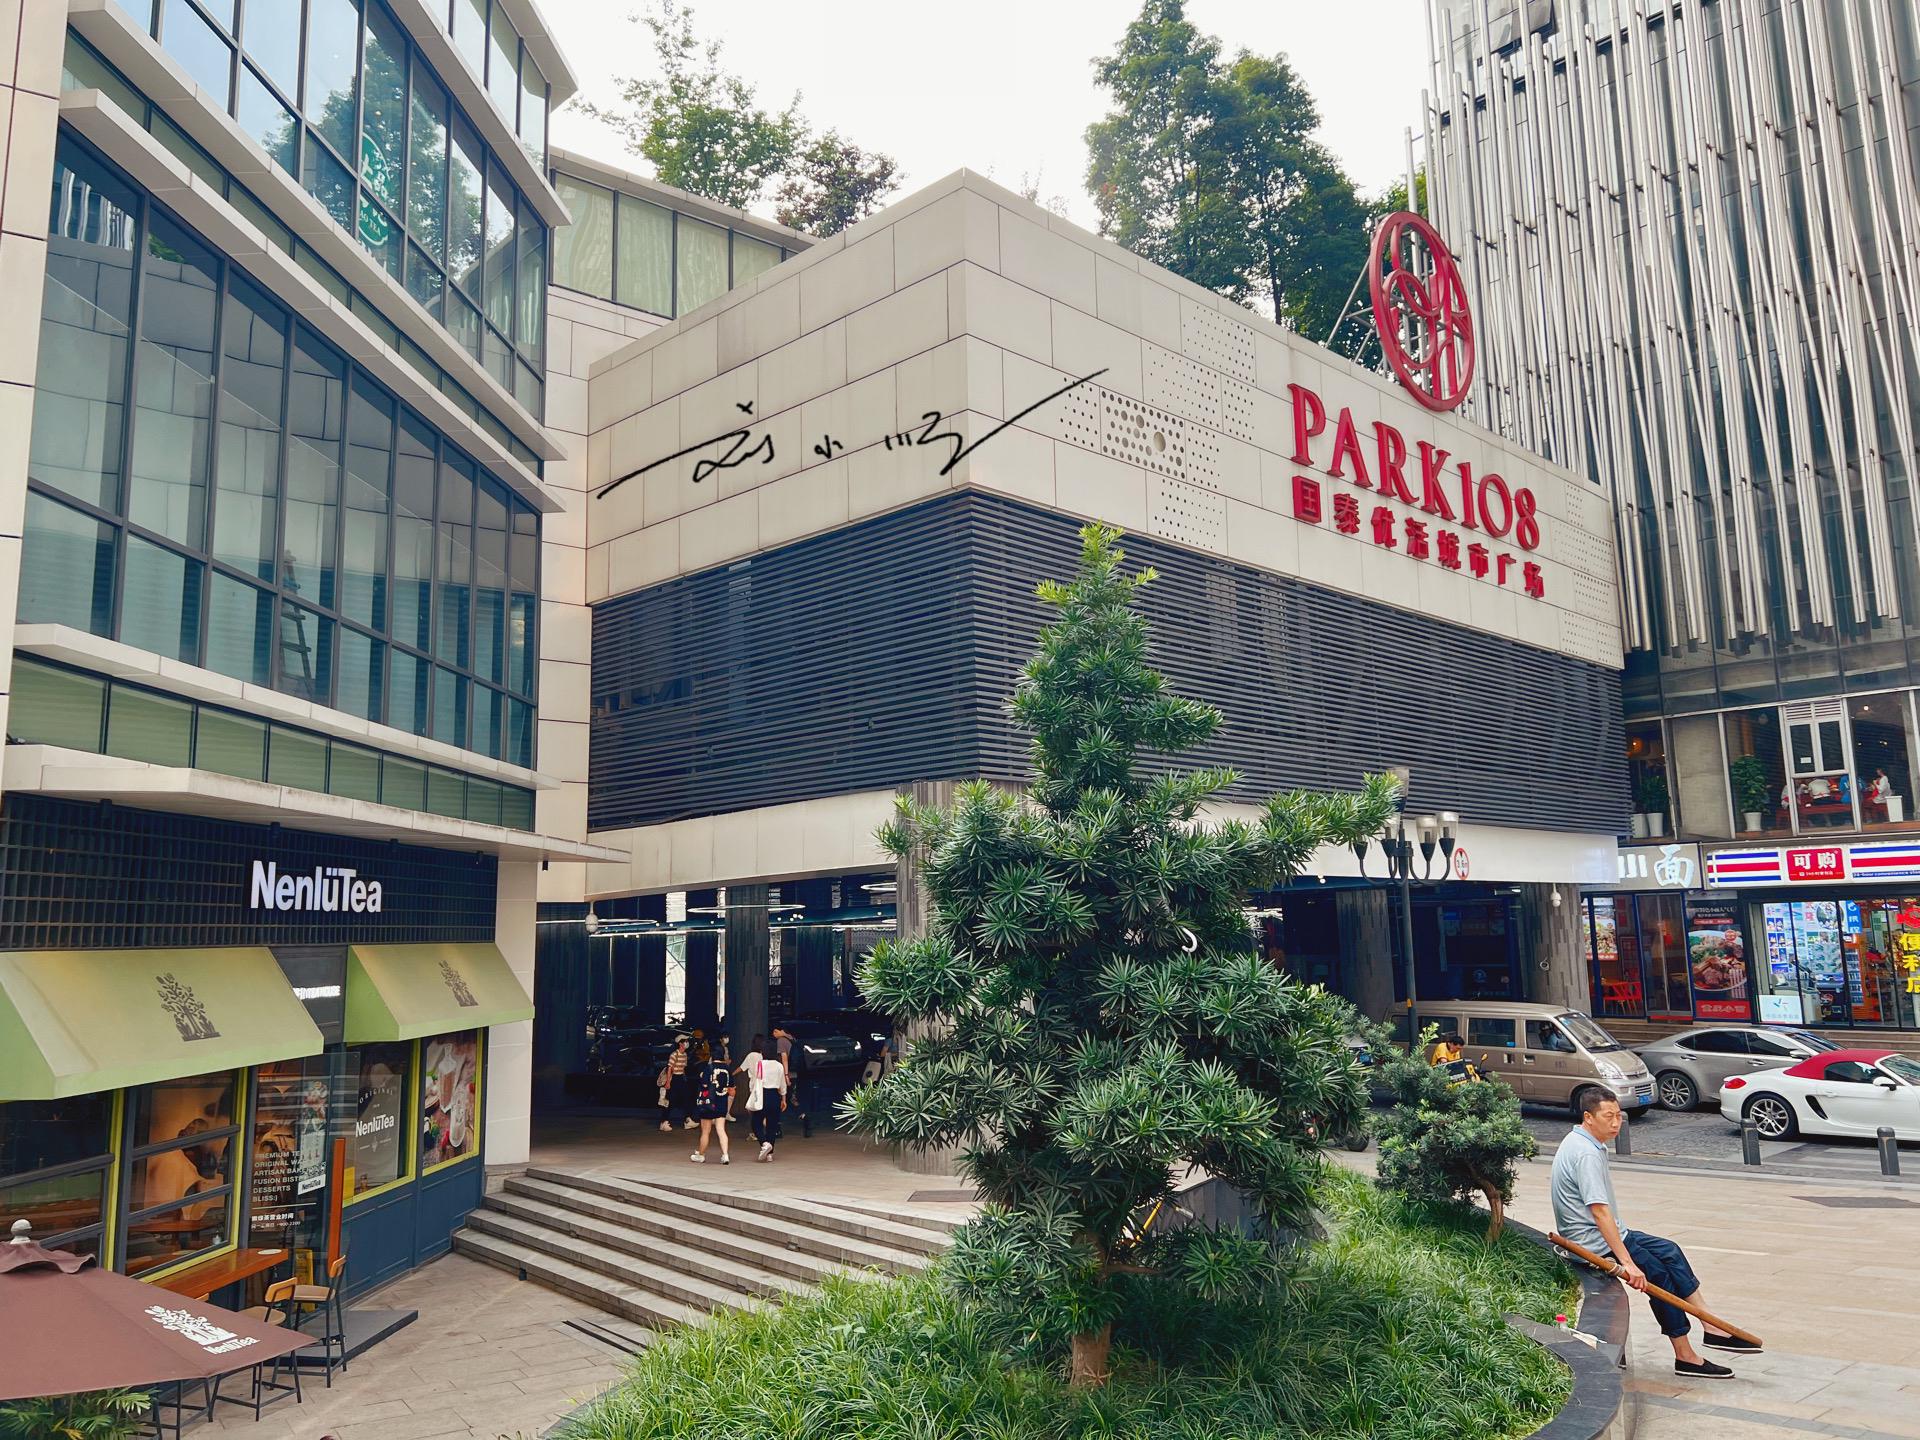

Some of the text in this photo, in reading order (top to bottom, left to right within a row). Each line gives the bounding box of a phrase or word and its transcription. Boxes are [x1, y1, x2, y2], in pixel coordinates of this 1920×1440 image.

[1287, 383, 1540, 551] PARK108
[1292, 475, 1545, 599] 国泰优活城市广场
[1792, 852, 1837, 870] 可购
[250, 860, 382, 913] NenlüTea
[255, 1151, 290, 1159] PREMIUM
[254, 1160, 289, 1168] ORIGINAL
[254, 1168, 285, 1177] ARTISAN
[253, 1177, 281, 1185] FUSION
[253, 1185, 291, 1193] DESSERTS
